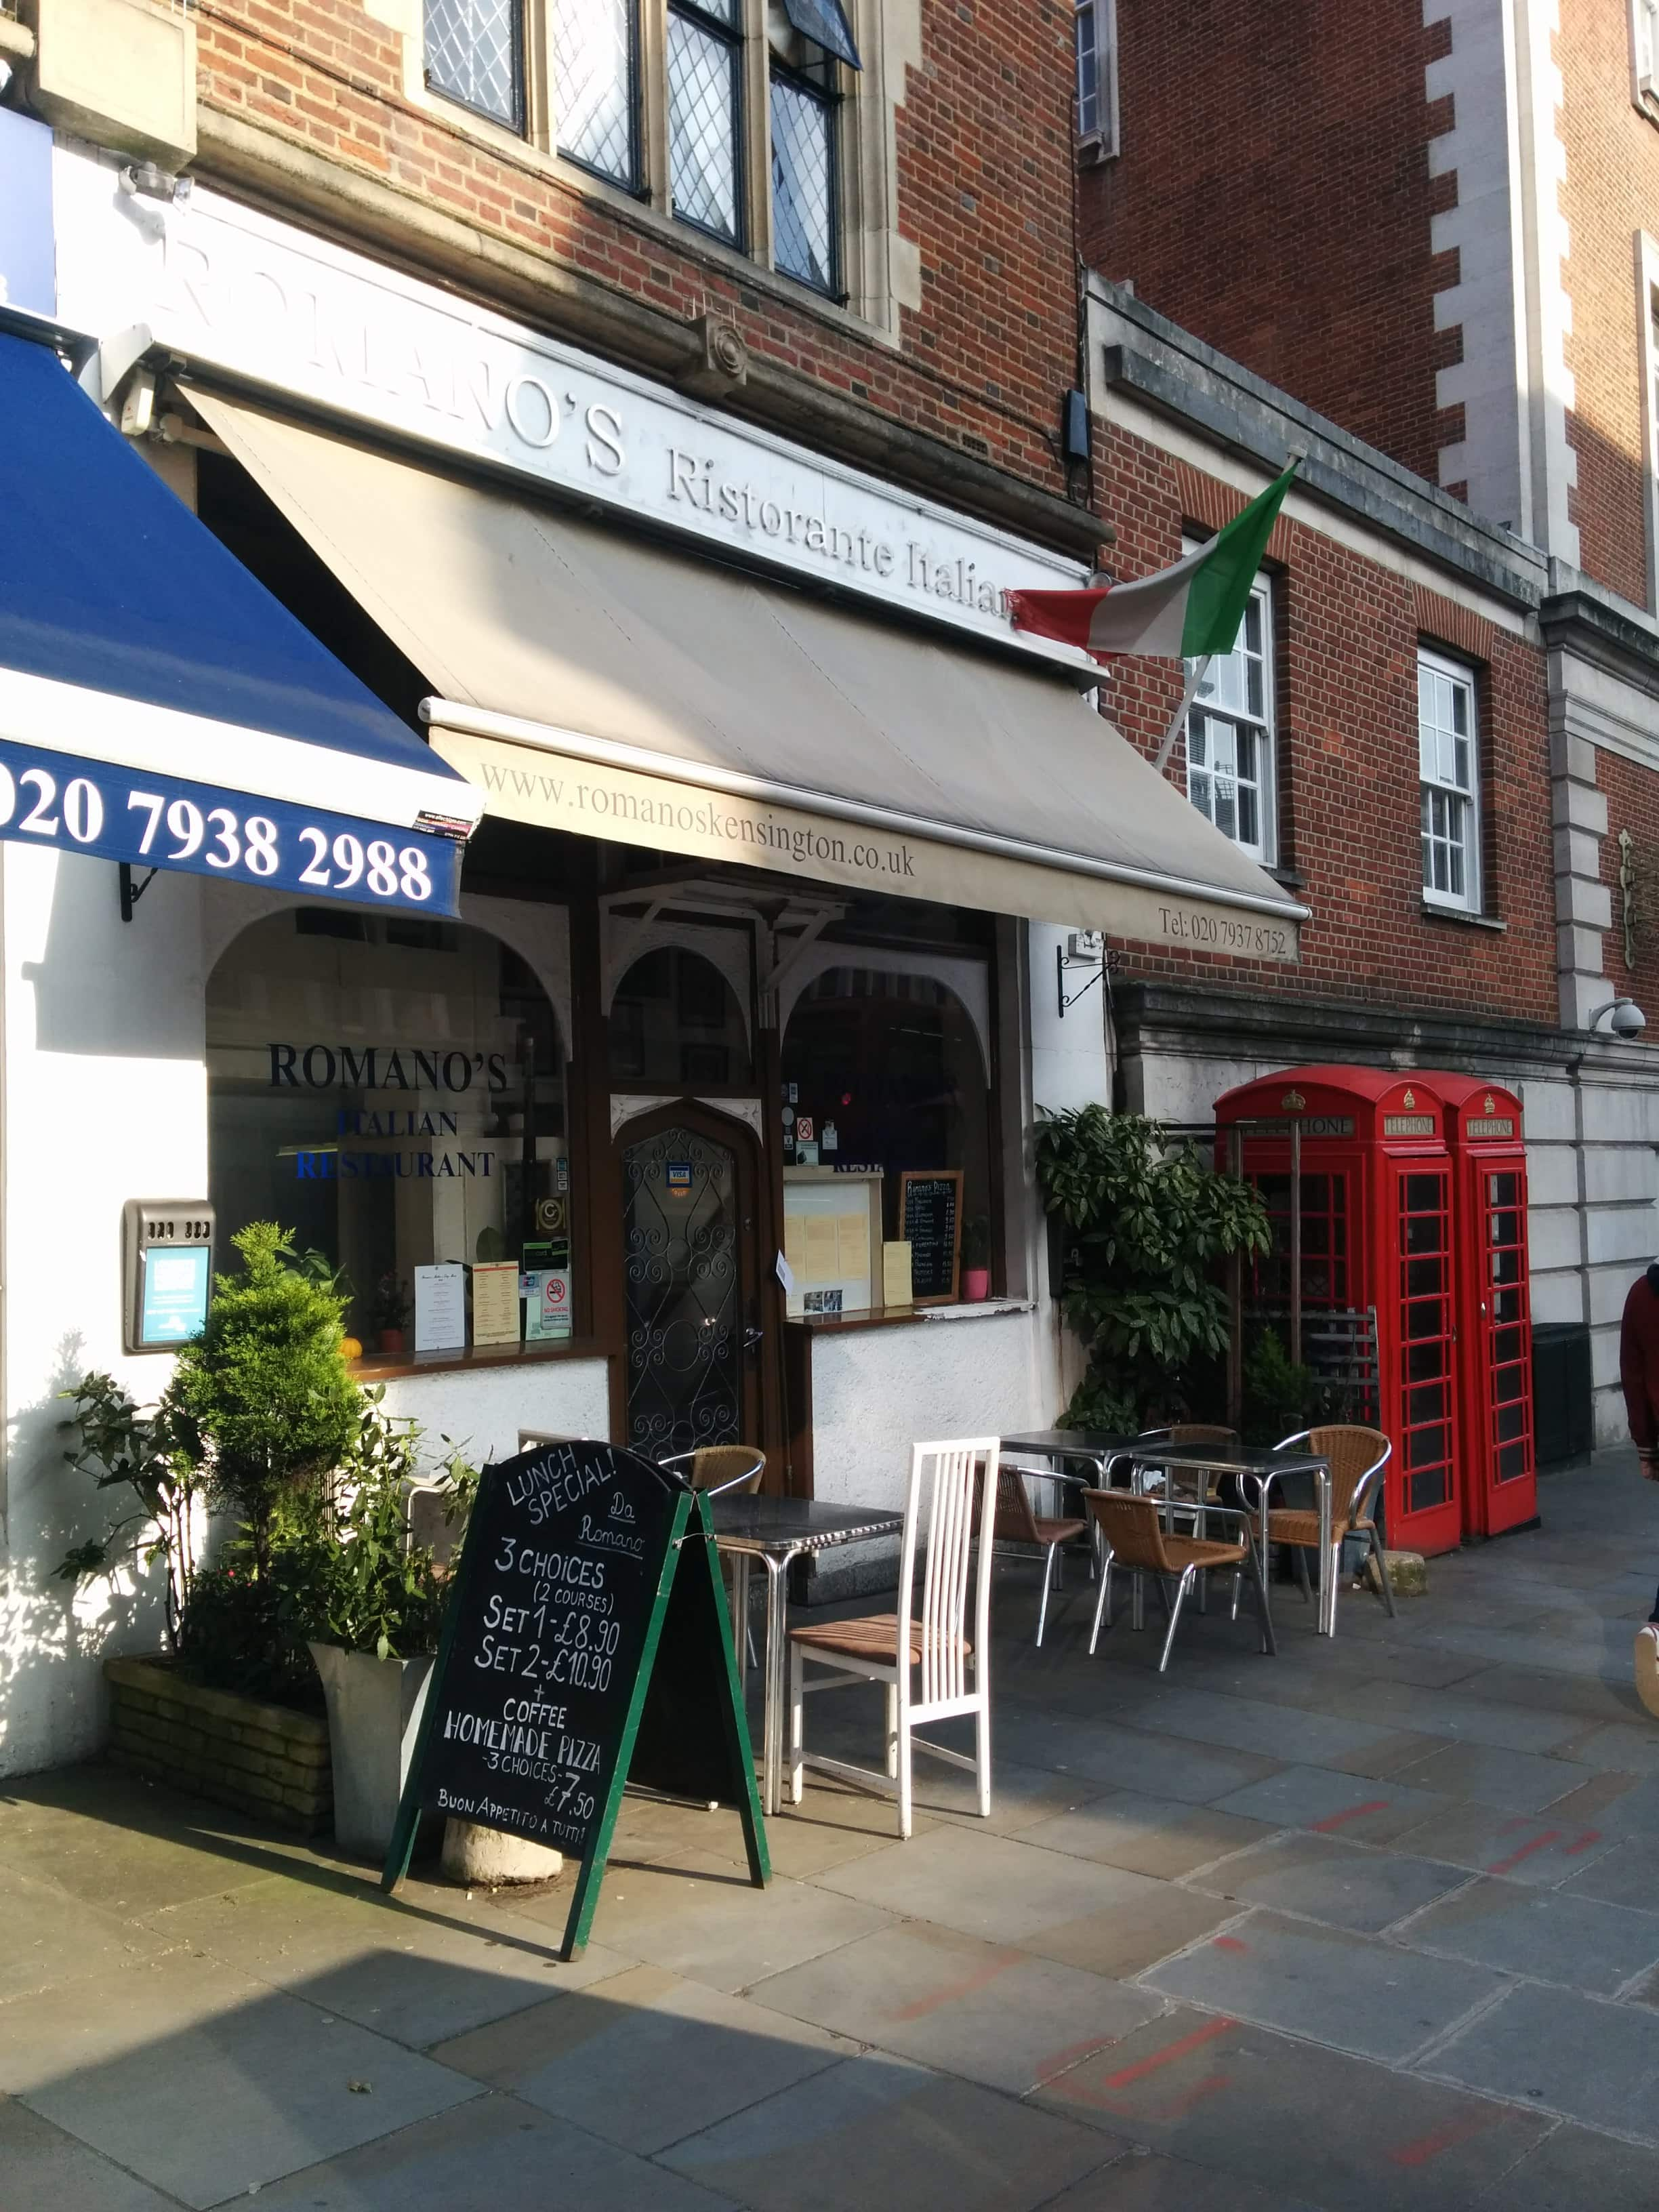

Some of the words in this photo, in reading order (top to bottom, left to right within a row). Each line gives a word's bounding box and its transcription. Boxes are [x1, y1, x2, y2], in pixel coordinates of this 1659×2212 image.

[667, 447, 895, 577] Ristorante
[480, 763, 915, 877] www.romanoskensington.co.uk
[127, 790, 279, 876] 7938
[299, 827, 432, 901] 2988
[1159, 908, 1188, 937] Tel:
[1191, 915, 1217, 943] 020
[1220, 921, 1251, 949] 7937
[1256, 928, 1286, 954] 8752
[268, 1044, 508, 1094] ROMANO'S
[337, 1109, 458, 1137] ITALIAN
[1385, 1116, 1433, 1134] TELEPHONE
[1467, 1119, 1512, 1135] TELEPHONE
[295, 1149, 495, 1180] RESTAURANT
[507, 1443, 577, 1507] LUNCH
[528, 1448, 617, 1525] SPECIAL!
[610, 1492, 635, 1519] Da
[577, 1515, 644, 1552] Romano
[495, 1536, 516, 1572] 3
[483, 1595, 529, 1633] SET
[554, 1587, 614, 1616] COURSES)
[474, 1635, 521, 1672] SET
[534, 1684, 545, 1702] +
[503, 1698, 567, 1729] COFFEE
[444, 1710, 552, 1760] HOMEMADE
[557, 1735, 600, 1775] PIZZA
[438, 1788, 475, 1813] BUON
[476, 1797, 537, 1829] APPETITO
[540, 1819, 548, 1832] A
